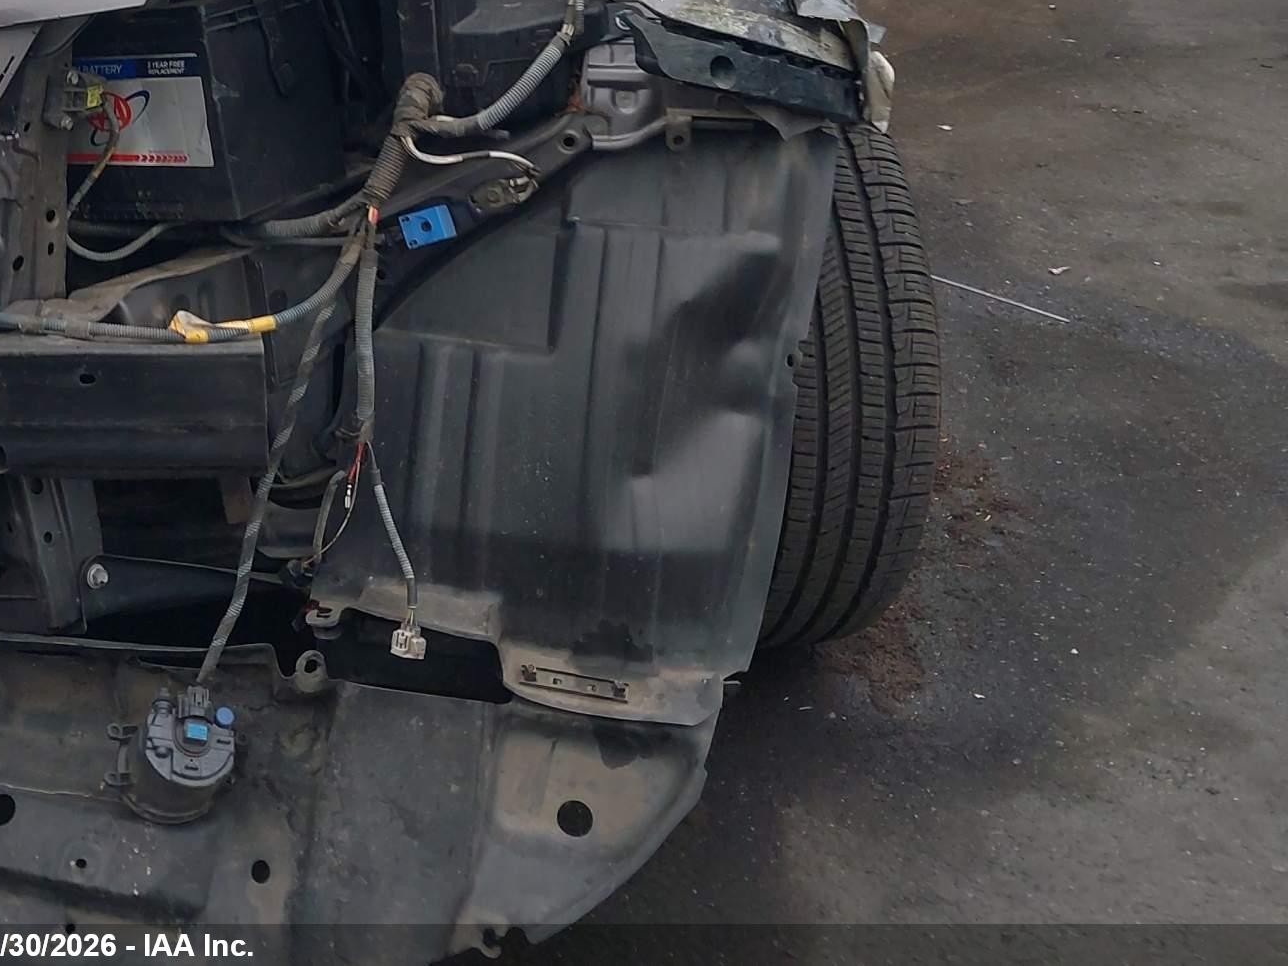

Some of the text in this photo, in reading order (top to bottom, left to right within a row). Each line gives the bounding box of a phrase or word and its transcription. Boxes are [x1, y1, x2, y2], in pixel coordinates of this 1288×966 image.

[152, 60, 168, 68] YEAR
[169, 59, 185, 68] FREE
[82, 64, 122, 75] BATTERY
